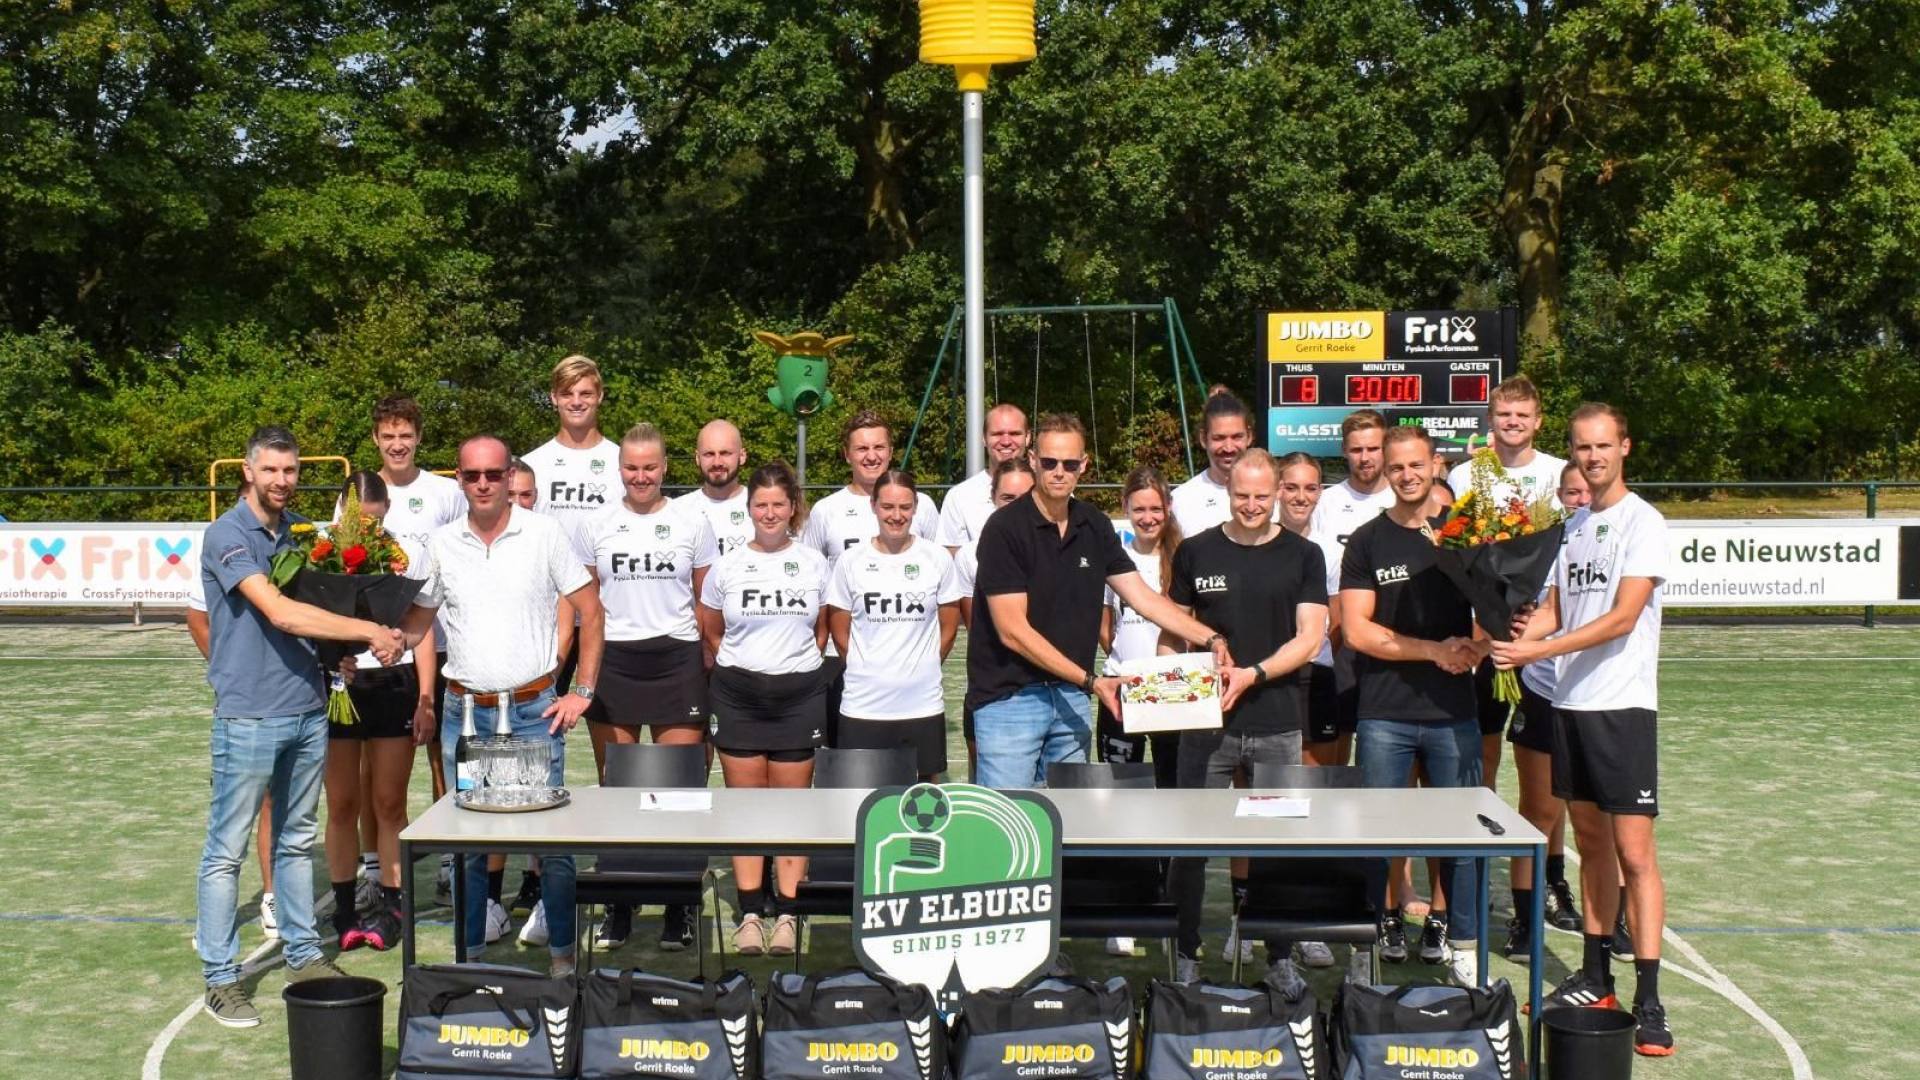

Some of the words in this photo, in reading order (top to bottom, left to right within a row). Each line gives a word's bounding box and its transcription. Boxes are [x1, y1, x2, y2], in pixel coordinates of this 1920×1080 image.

[1280, 320, 1373, 340] JUMBO
[1296, 343, 1323, 352] Gerrit
[1326, 343, 1356, 352] Roeke
[804, 365, 813, 377] 2
[1286, 364, 1314, 372] THUIS
[1362, 363, 1405, 372] MINUTEN
[1450, 363, 1490, 371] GASTEN
[1301, 377, 1316, 401] 8
[1480, 376, 1486, 400] 1
[1681, 539, 1716, 563] de
[1726, 539, 1881, 563] Nieuwstad
[862, 897, 910, 930] KV
[919, 884, 1052, 925] ELBURG
[893, 934, 962, 954] SINDS
[974, 928, 1026, 947] 1977
[652, 996, 679, 1006] erima
[835, 1000, 863, 1009] erima
[1034, 1000, 1063, 1009] erima
[1221, 1005, 1251, 1014] erima
[438, 1024, 529, 1048] JUMBO
[452, 1048, 480, 1058] Gerrit
[482, 1050, 512, 1060] Roeke
[618, 1038, 710, 1061] JUMBO
[806, 1041, 899, 1061] JUMBO
[1002, 1043, 1095, 1064] JUMBO
[1190, 1048, 1283, 1069] JUMBO
[1384, 1046, 1479, 1068] JUMBO
[634, 1062, 662, 1072] Gerrit
[665, 1063, 695, 1073] Roeke
[822, 1065, 851, 1074] Gerrit
[853, 1065, 883, 1073] Roeke
[1017, 1066, 1045, 1076] Gerrit
[1048, 1066, 1077, 1075] Roeke
[1206, 1071, 1234, 1080] Gerrit
[1237, 1071, 1268, 1080] Roeke
[1401, 1069, 1430, 1079] Gerrit
[1432, 1071, 1464, 1080] Roeke
